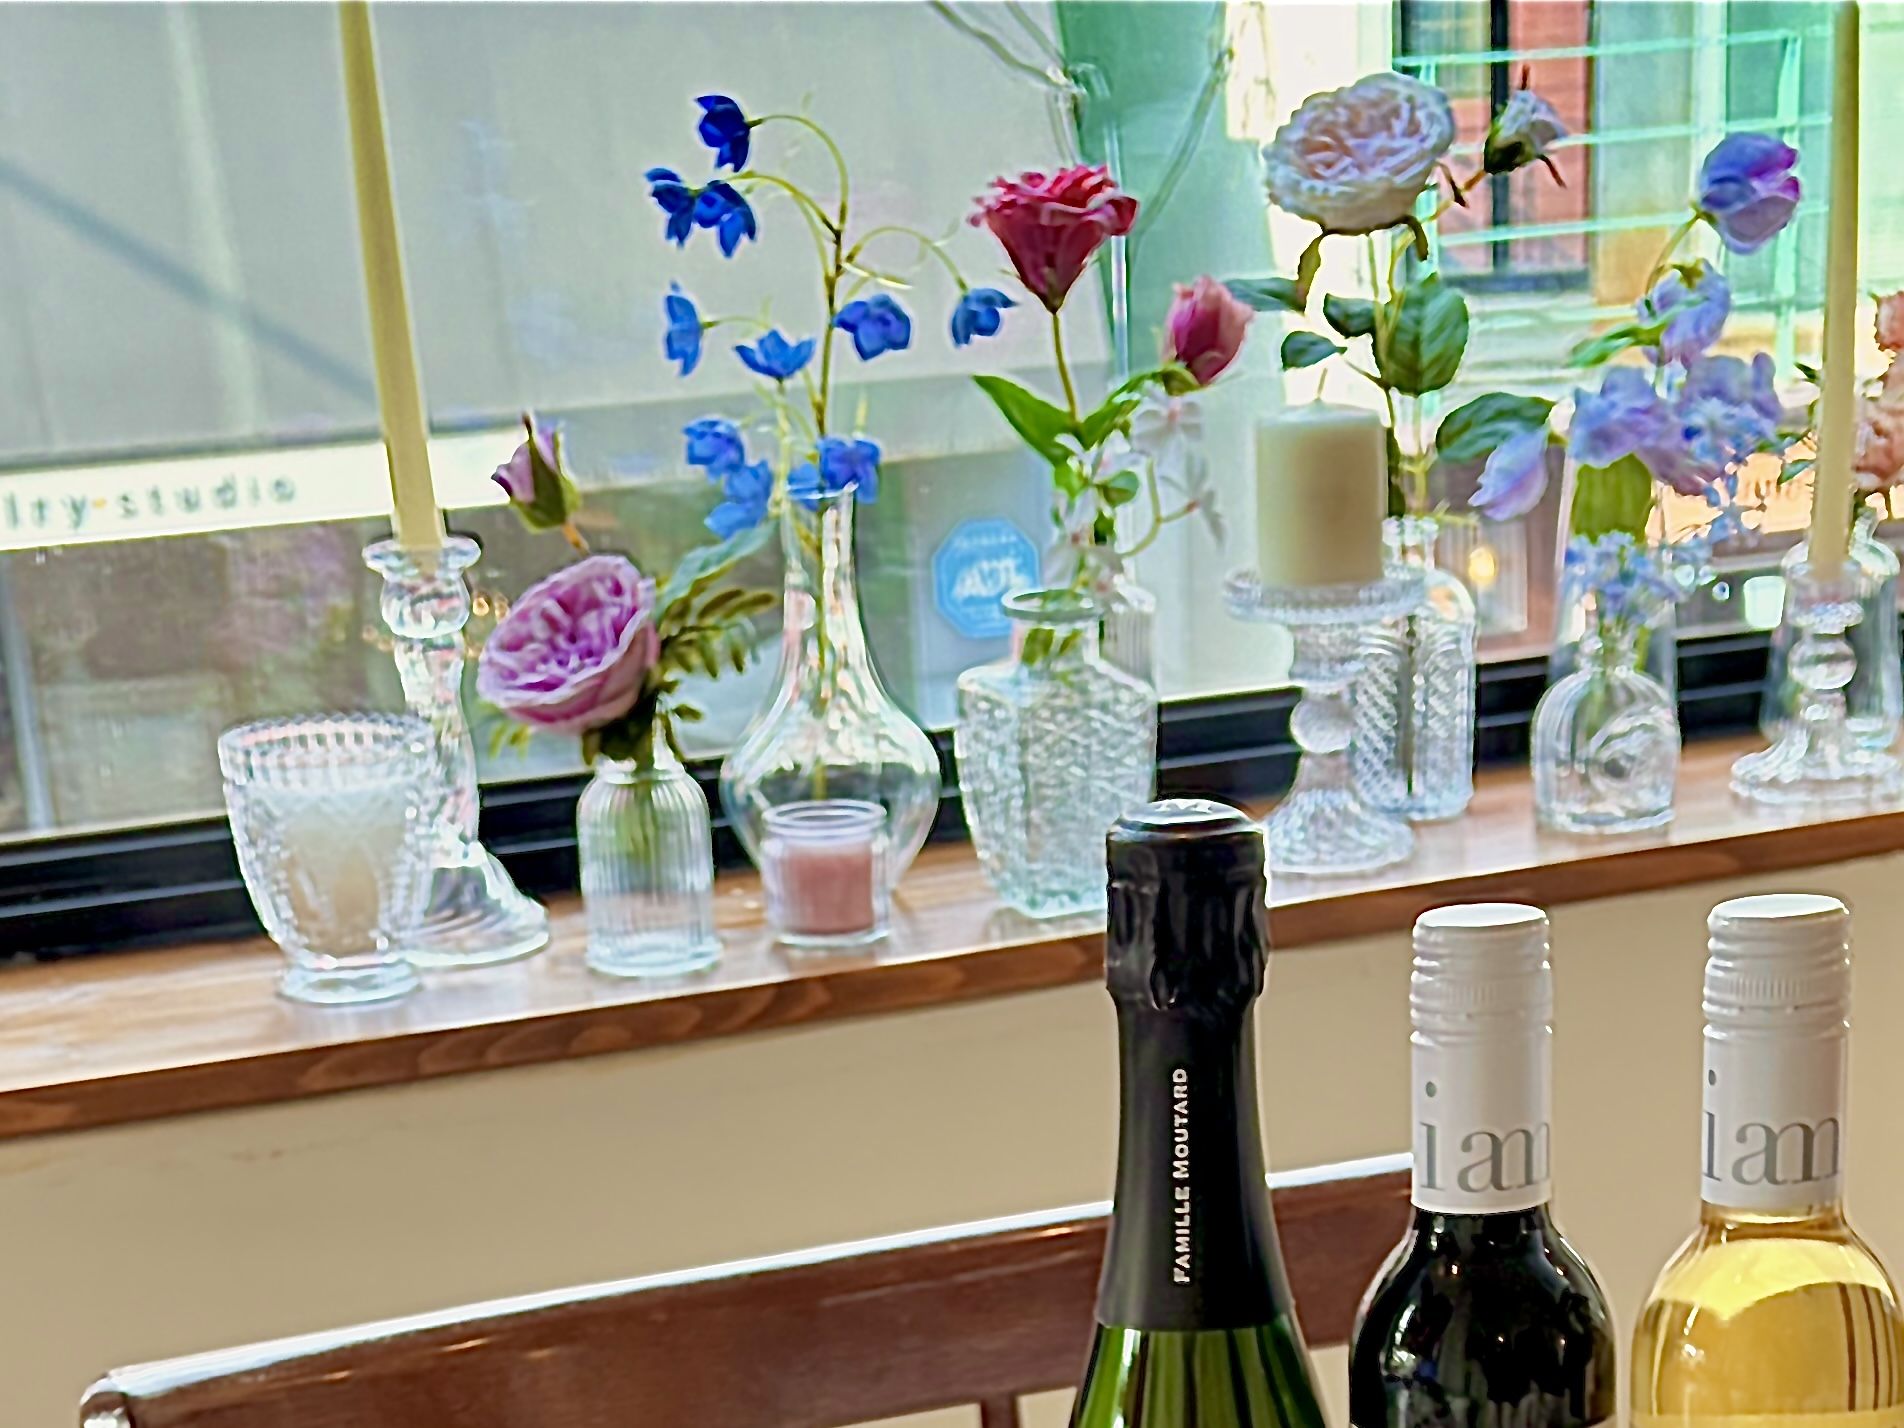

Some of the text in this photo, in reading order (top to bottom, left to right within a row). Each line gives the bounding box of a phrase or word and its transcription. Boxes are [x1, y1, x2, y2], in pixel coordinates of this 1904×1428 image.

[1172, 1068, 1191, 1284] FAMILLE MOUTARD
[1731, 1116, 1842, 1186] am
